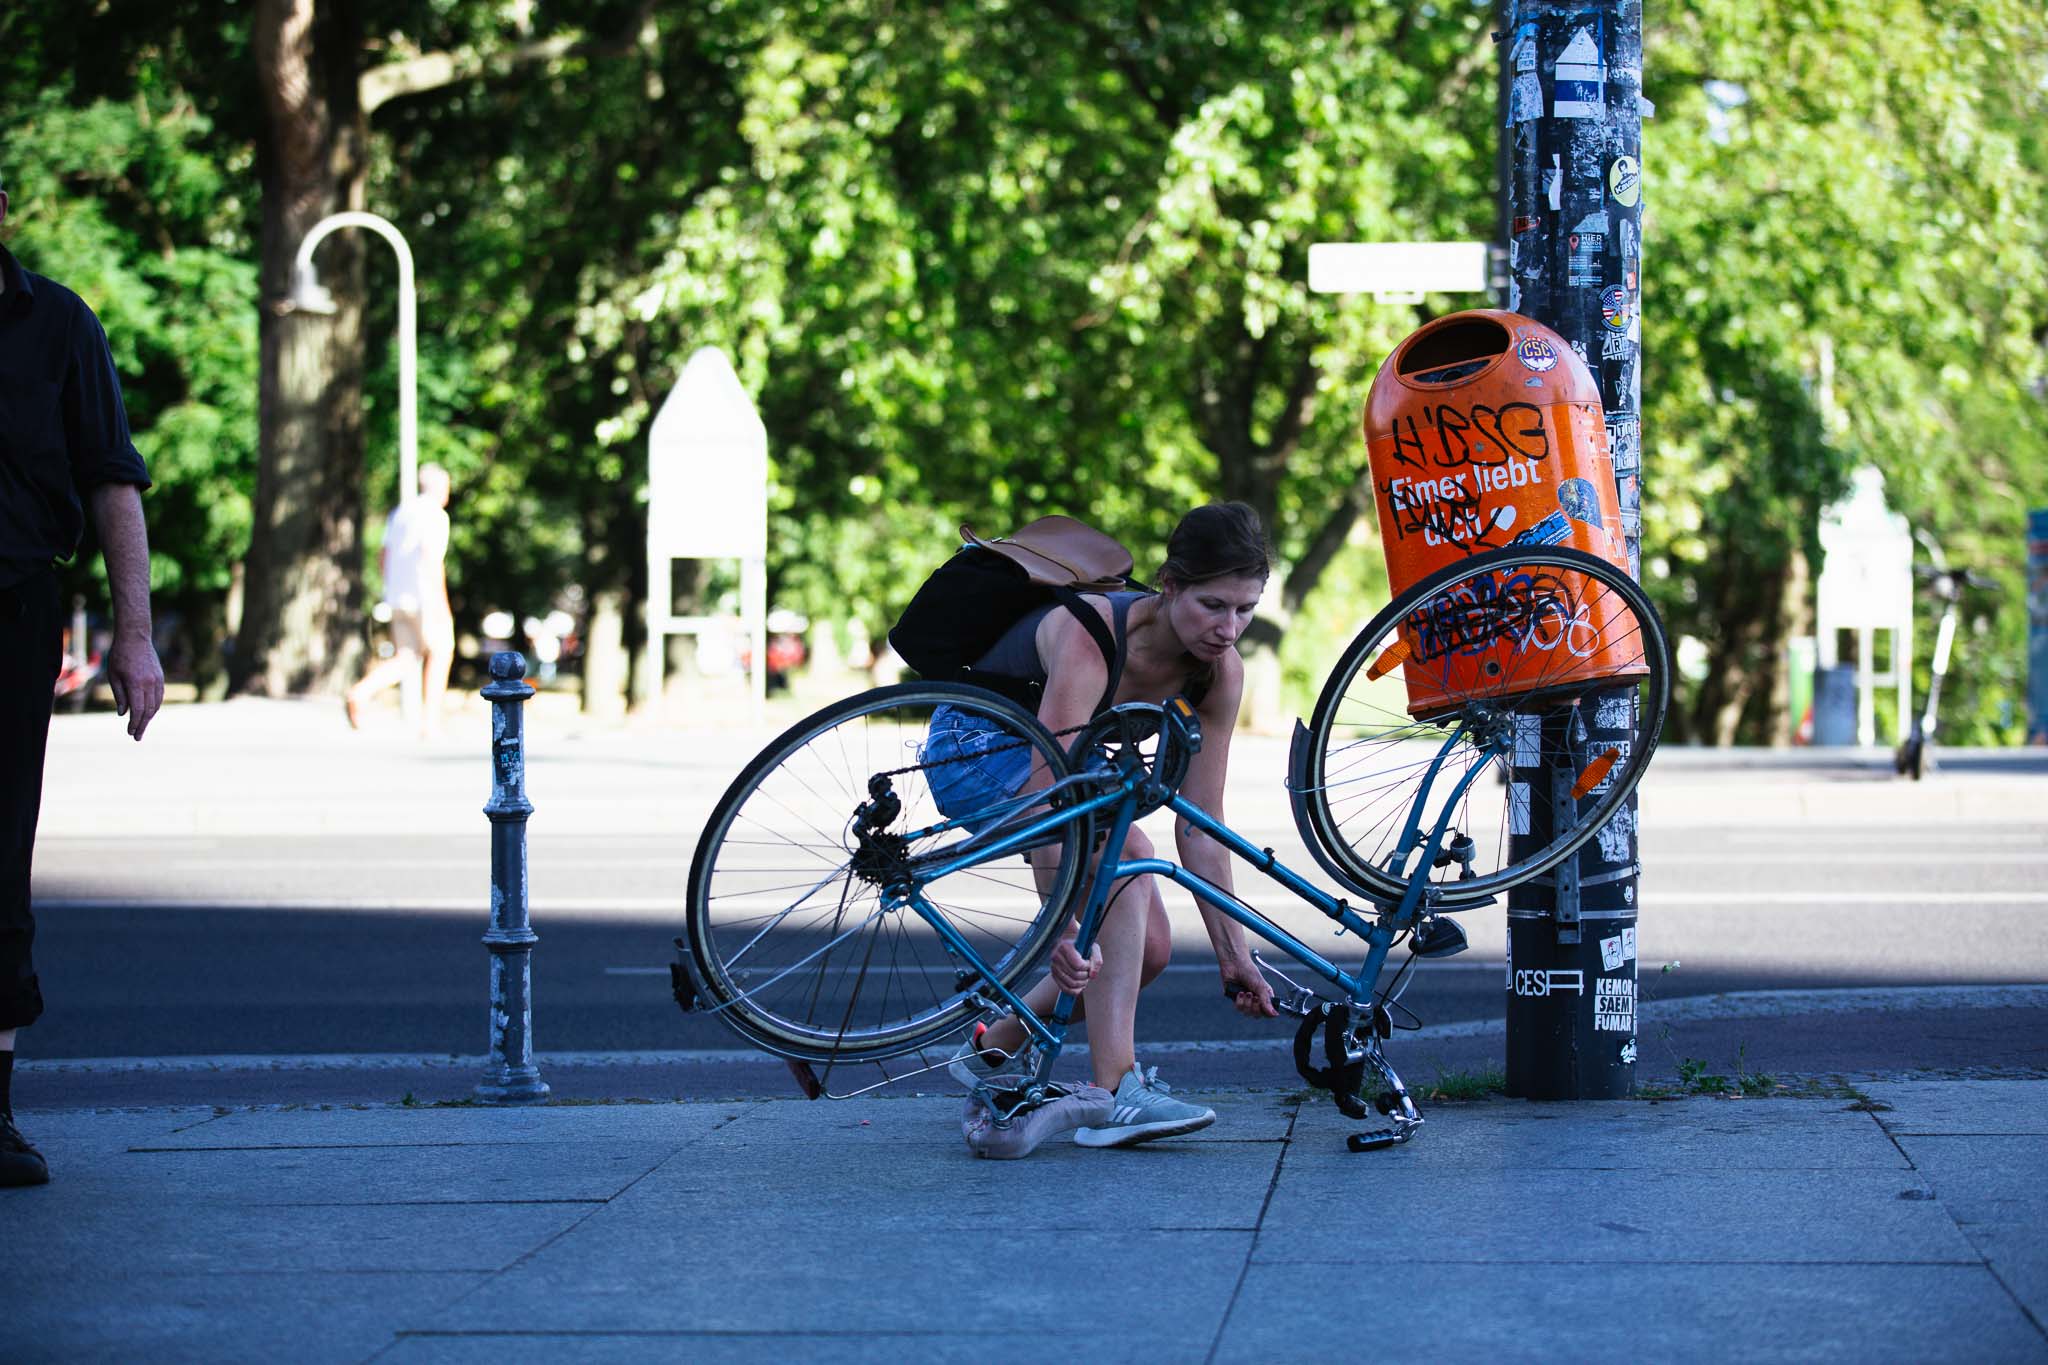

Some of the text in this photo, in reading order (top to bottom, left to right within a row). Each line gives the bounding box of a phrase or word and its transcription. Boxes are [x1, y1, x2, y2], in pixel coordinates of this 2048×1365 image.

[1581, 233, 1602, 241] HIER
[1524, 341, 1551, 357] CSC
[1391, 456, 1542, 511] Eimer liebt
[1424, 507, 1483, 546] dich
[1596, 978, 1632, 995] KEMOR
[1600, 997, 1630, 1012] SAEM
[1594, 1014, 1631, 1031] FUMAR
